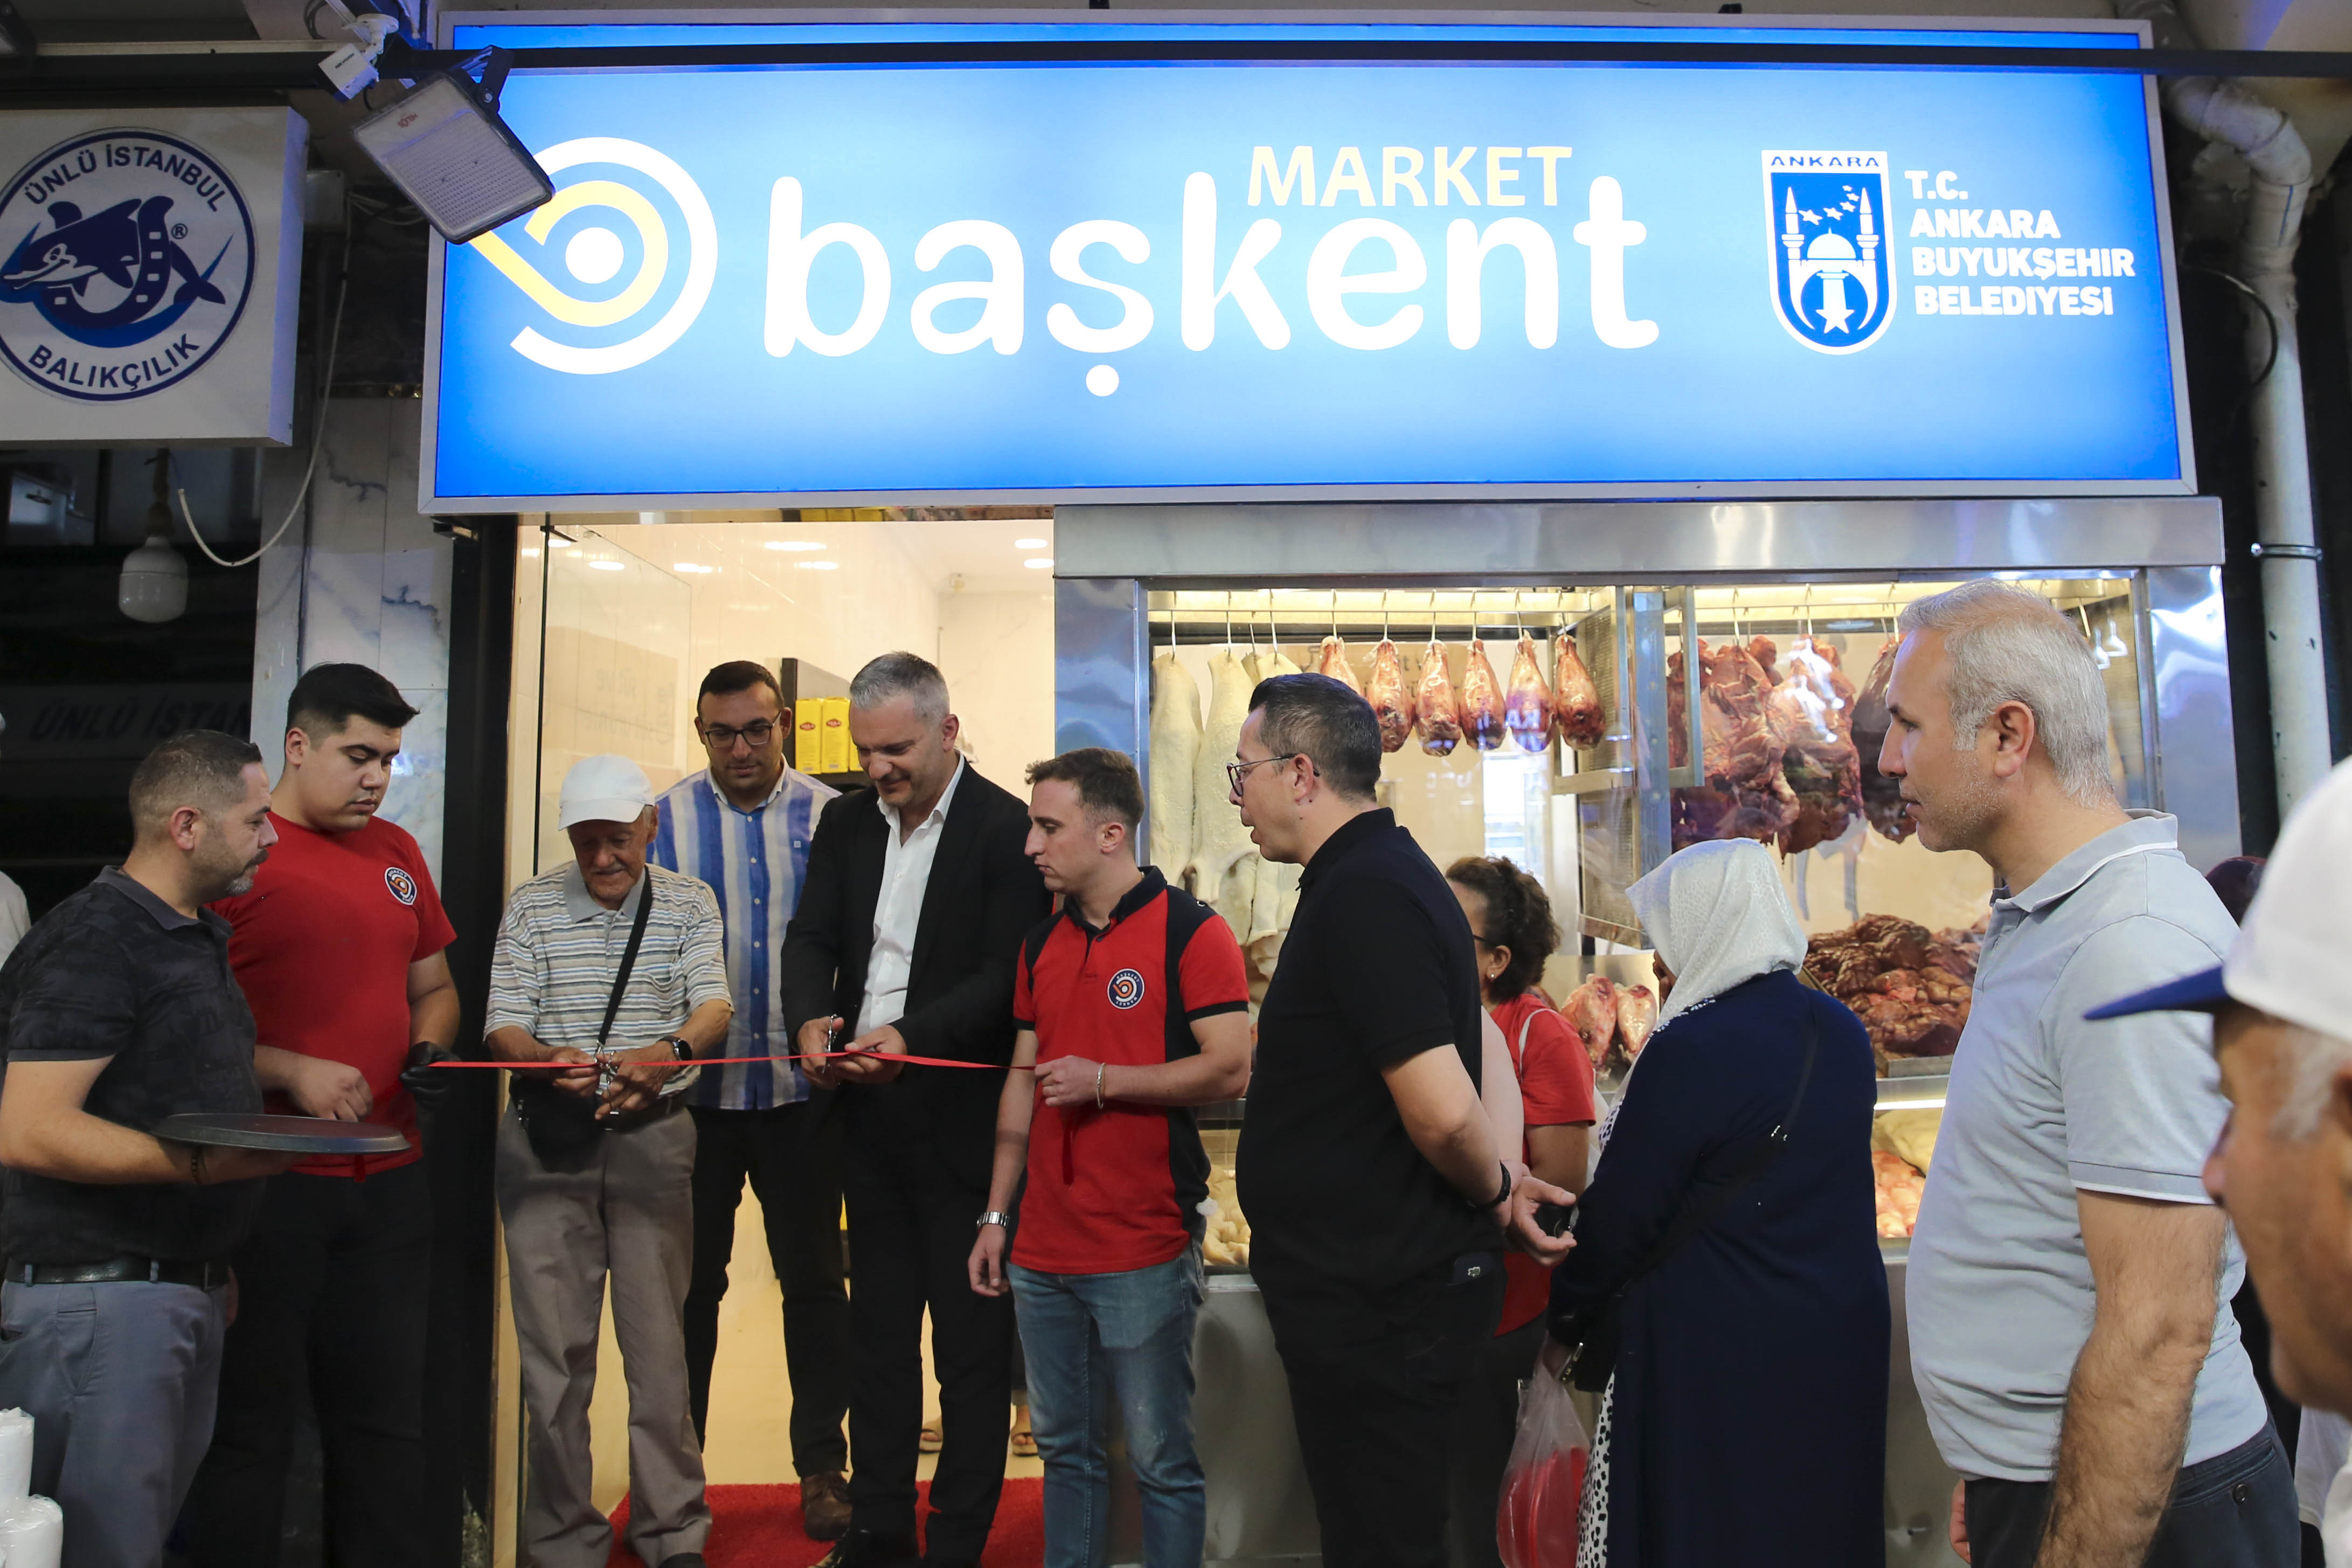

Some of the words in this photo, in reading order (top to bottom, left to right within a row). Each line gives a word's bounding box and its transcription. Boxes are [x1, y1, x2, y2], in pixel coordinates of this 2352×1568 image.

[24, 149, 97, 204] ÜNLÜ
[106, 144, 226, 212] İSTANBUL
[1247, 145, 1573, 207] MARKET
[1770, 155, 1880, 168] ANKARA
[1904, 170, 1969, 200] T.C.
[1909, 208, 2062, 239] ANKARA
[763, 171, 1660, 397] başkent
[29, 334, 200, 391] BALIKÇILIK
